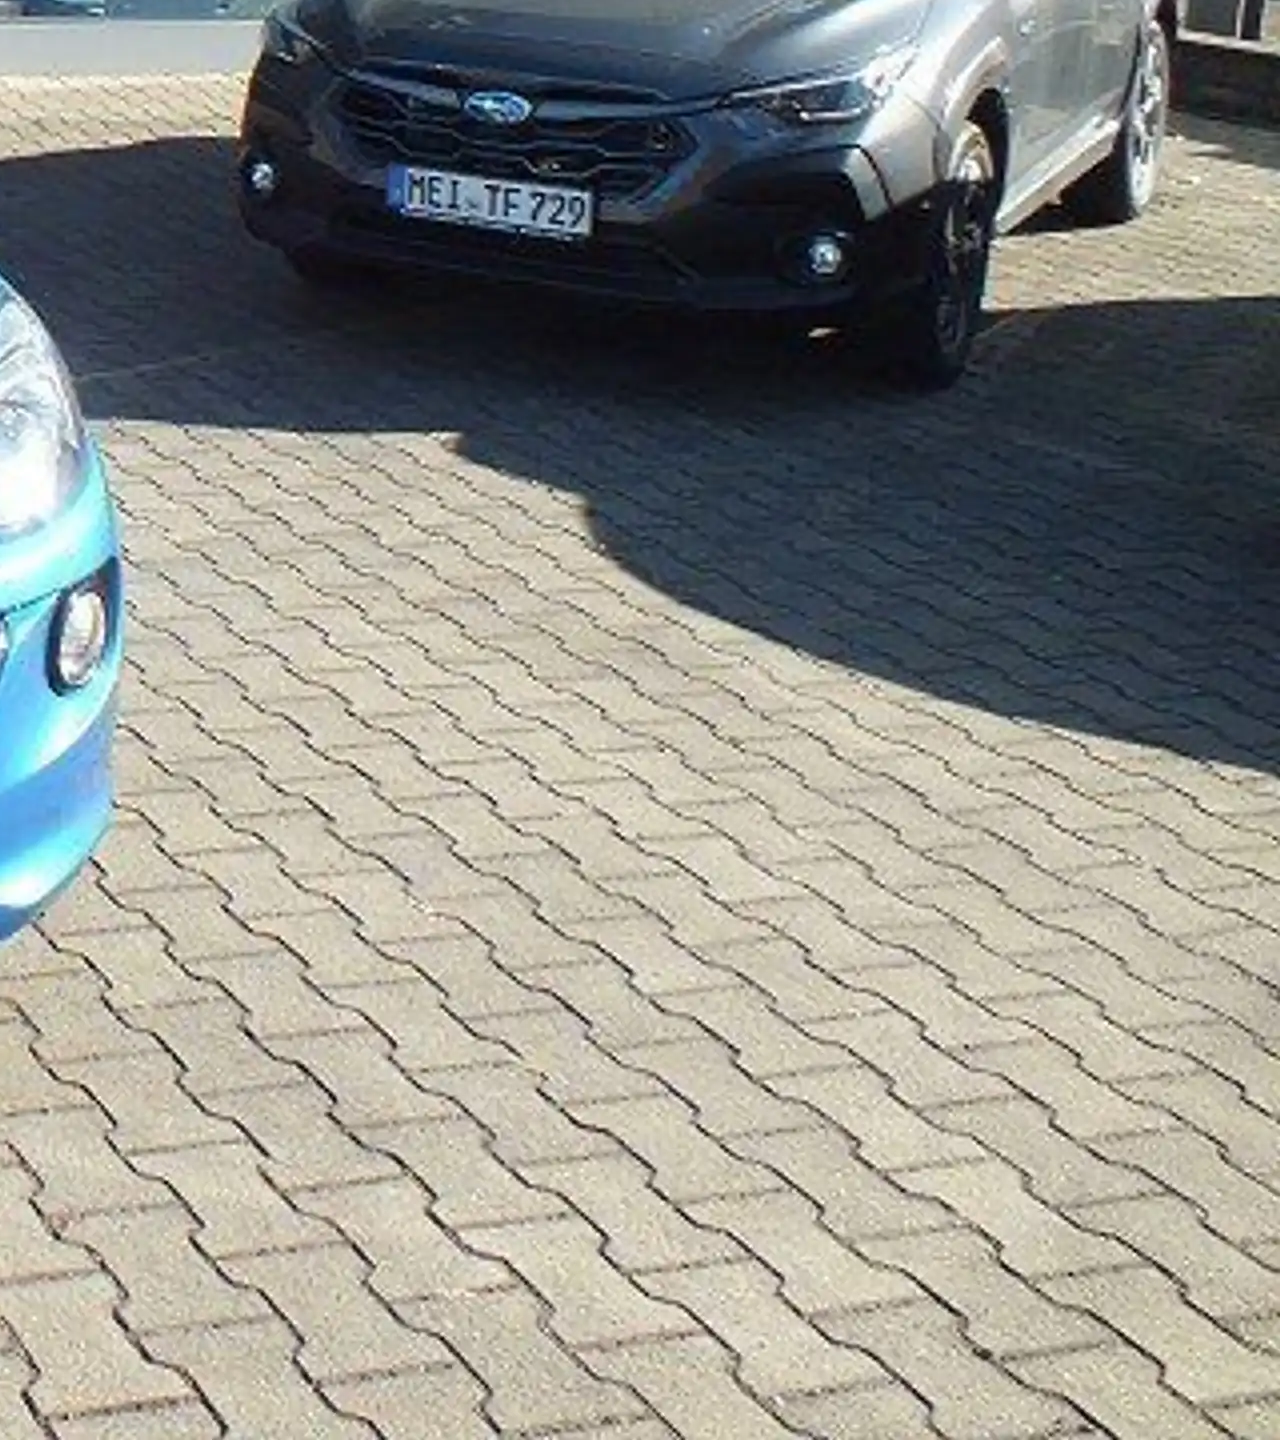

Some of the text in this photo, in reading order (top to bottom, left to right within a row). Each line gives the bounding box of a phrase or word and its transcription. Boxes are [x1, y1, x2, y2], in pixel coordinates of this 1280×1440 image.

[406, 171, 588, 229] MEI TF 729
